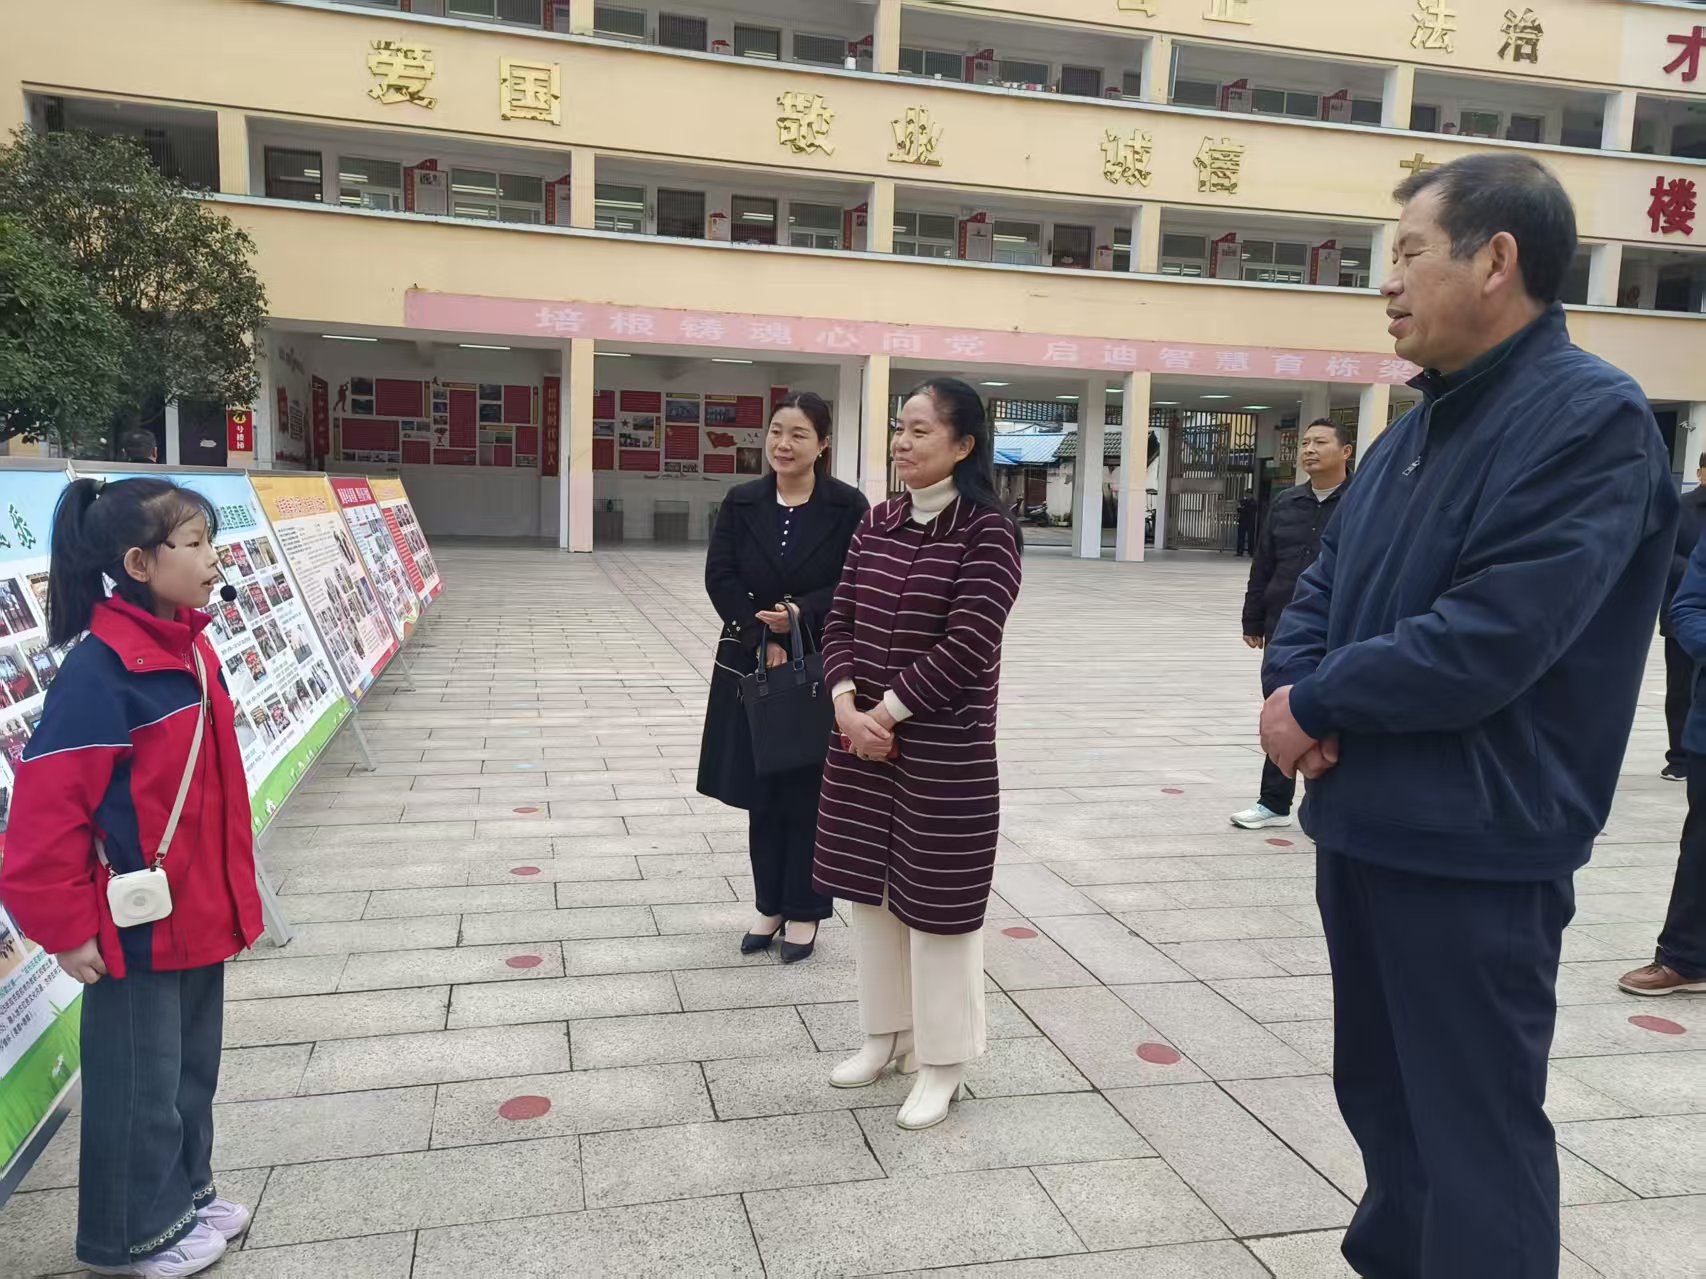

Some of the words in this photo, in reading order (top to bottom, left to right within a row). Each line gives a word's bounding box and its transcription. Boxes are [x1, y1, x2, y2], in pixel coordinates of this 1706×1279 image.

[1410, 0, 1545, 64] 法治
[367, 39, 561, 126] 爱国
[776, 91, 944, 166] 敬业
[1100, 129, 1246, 194] 诚信
[1648, 176, 1697, 235] 楼
[535, 307, 985, 356] 培根铸魂心向党
